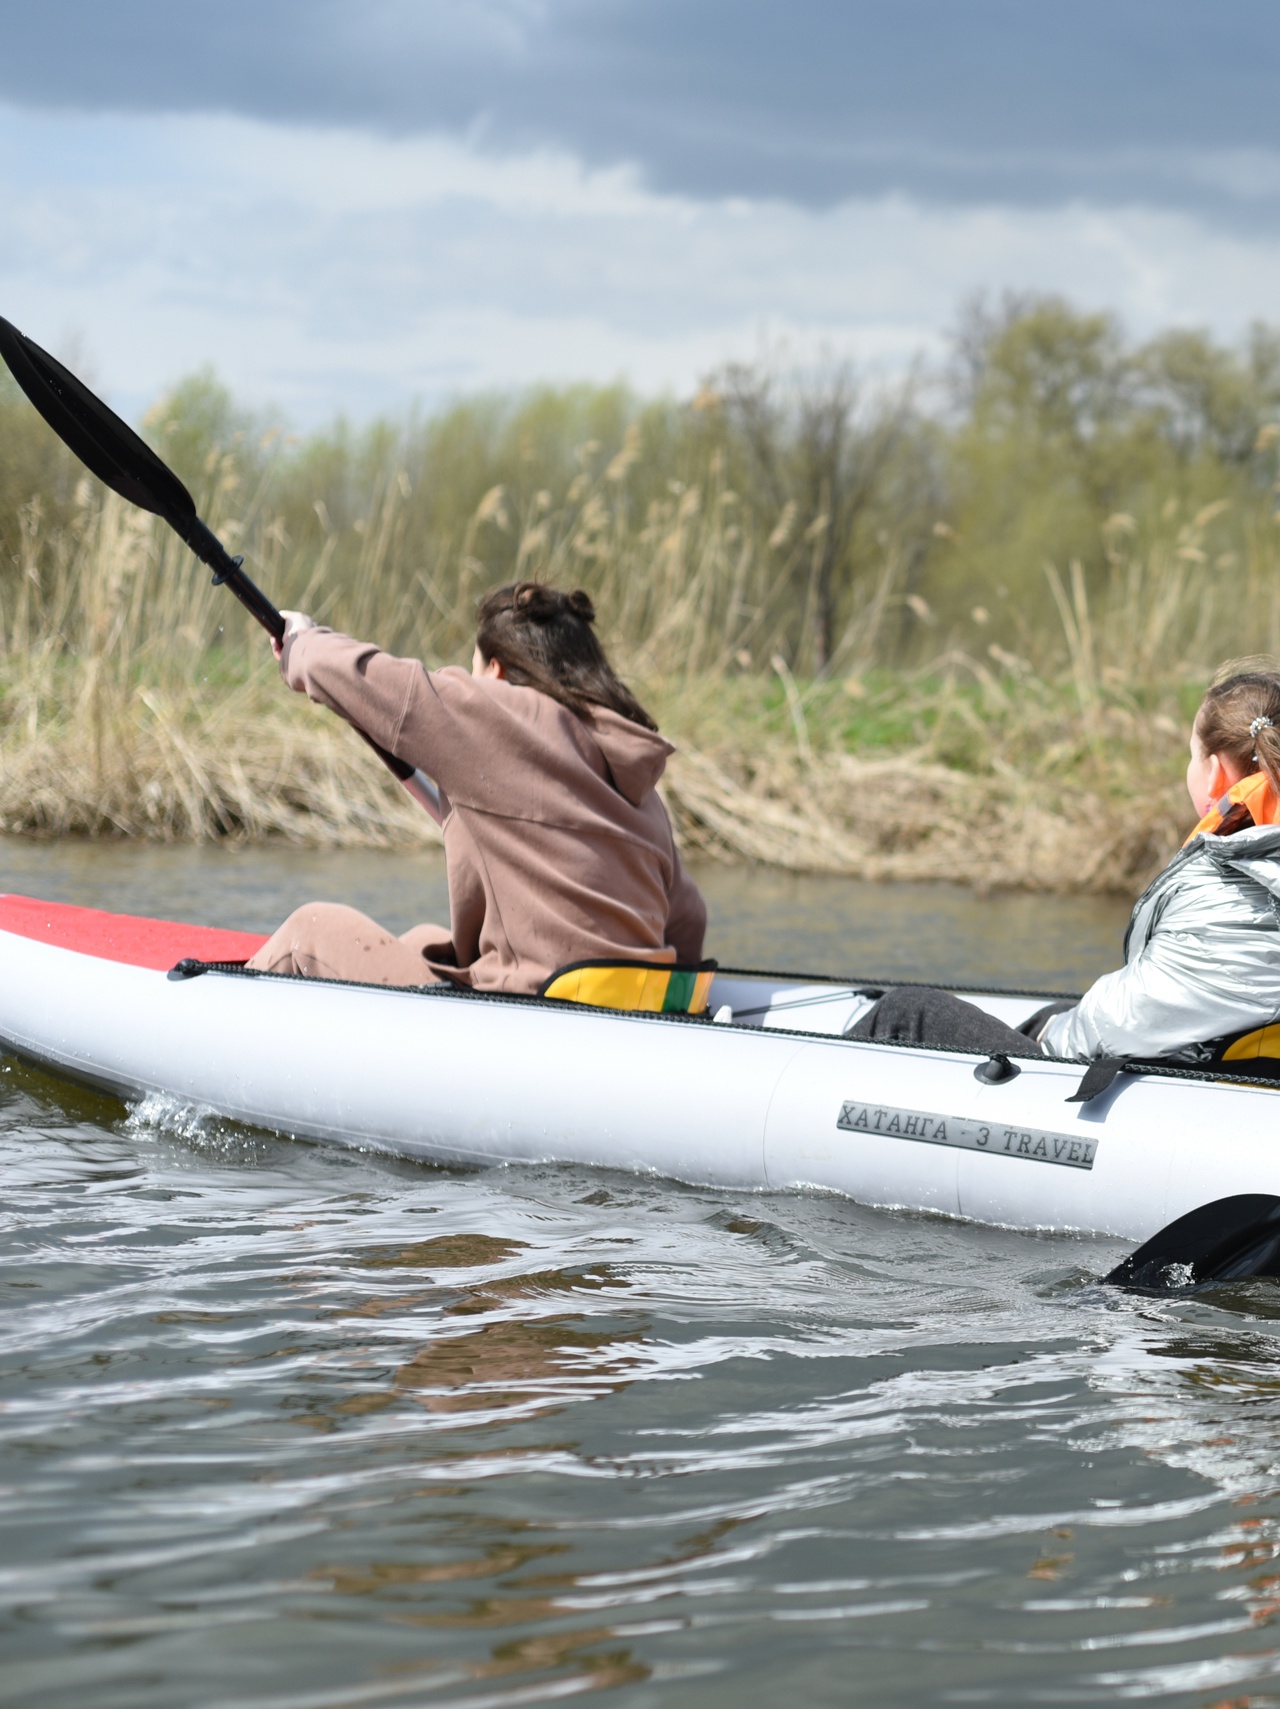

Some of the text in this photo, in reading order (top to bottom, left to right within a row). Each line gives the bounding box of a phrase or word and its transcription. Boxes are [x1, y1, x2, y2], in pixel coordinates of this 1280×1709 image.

[838, 1105, 948, 1140] ХАТАНГА
[976, 1127, 990, 1146] 3
[1003, 1131, 1093, 1163] TRAVEL
